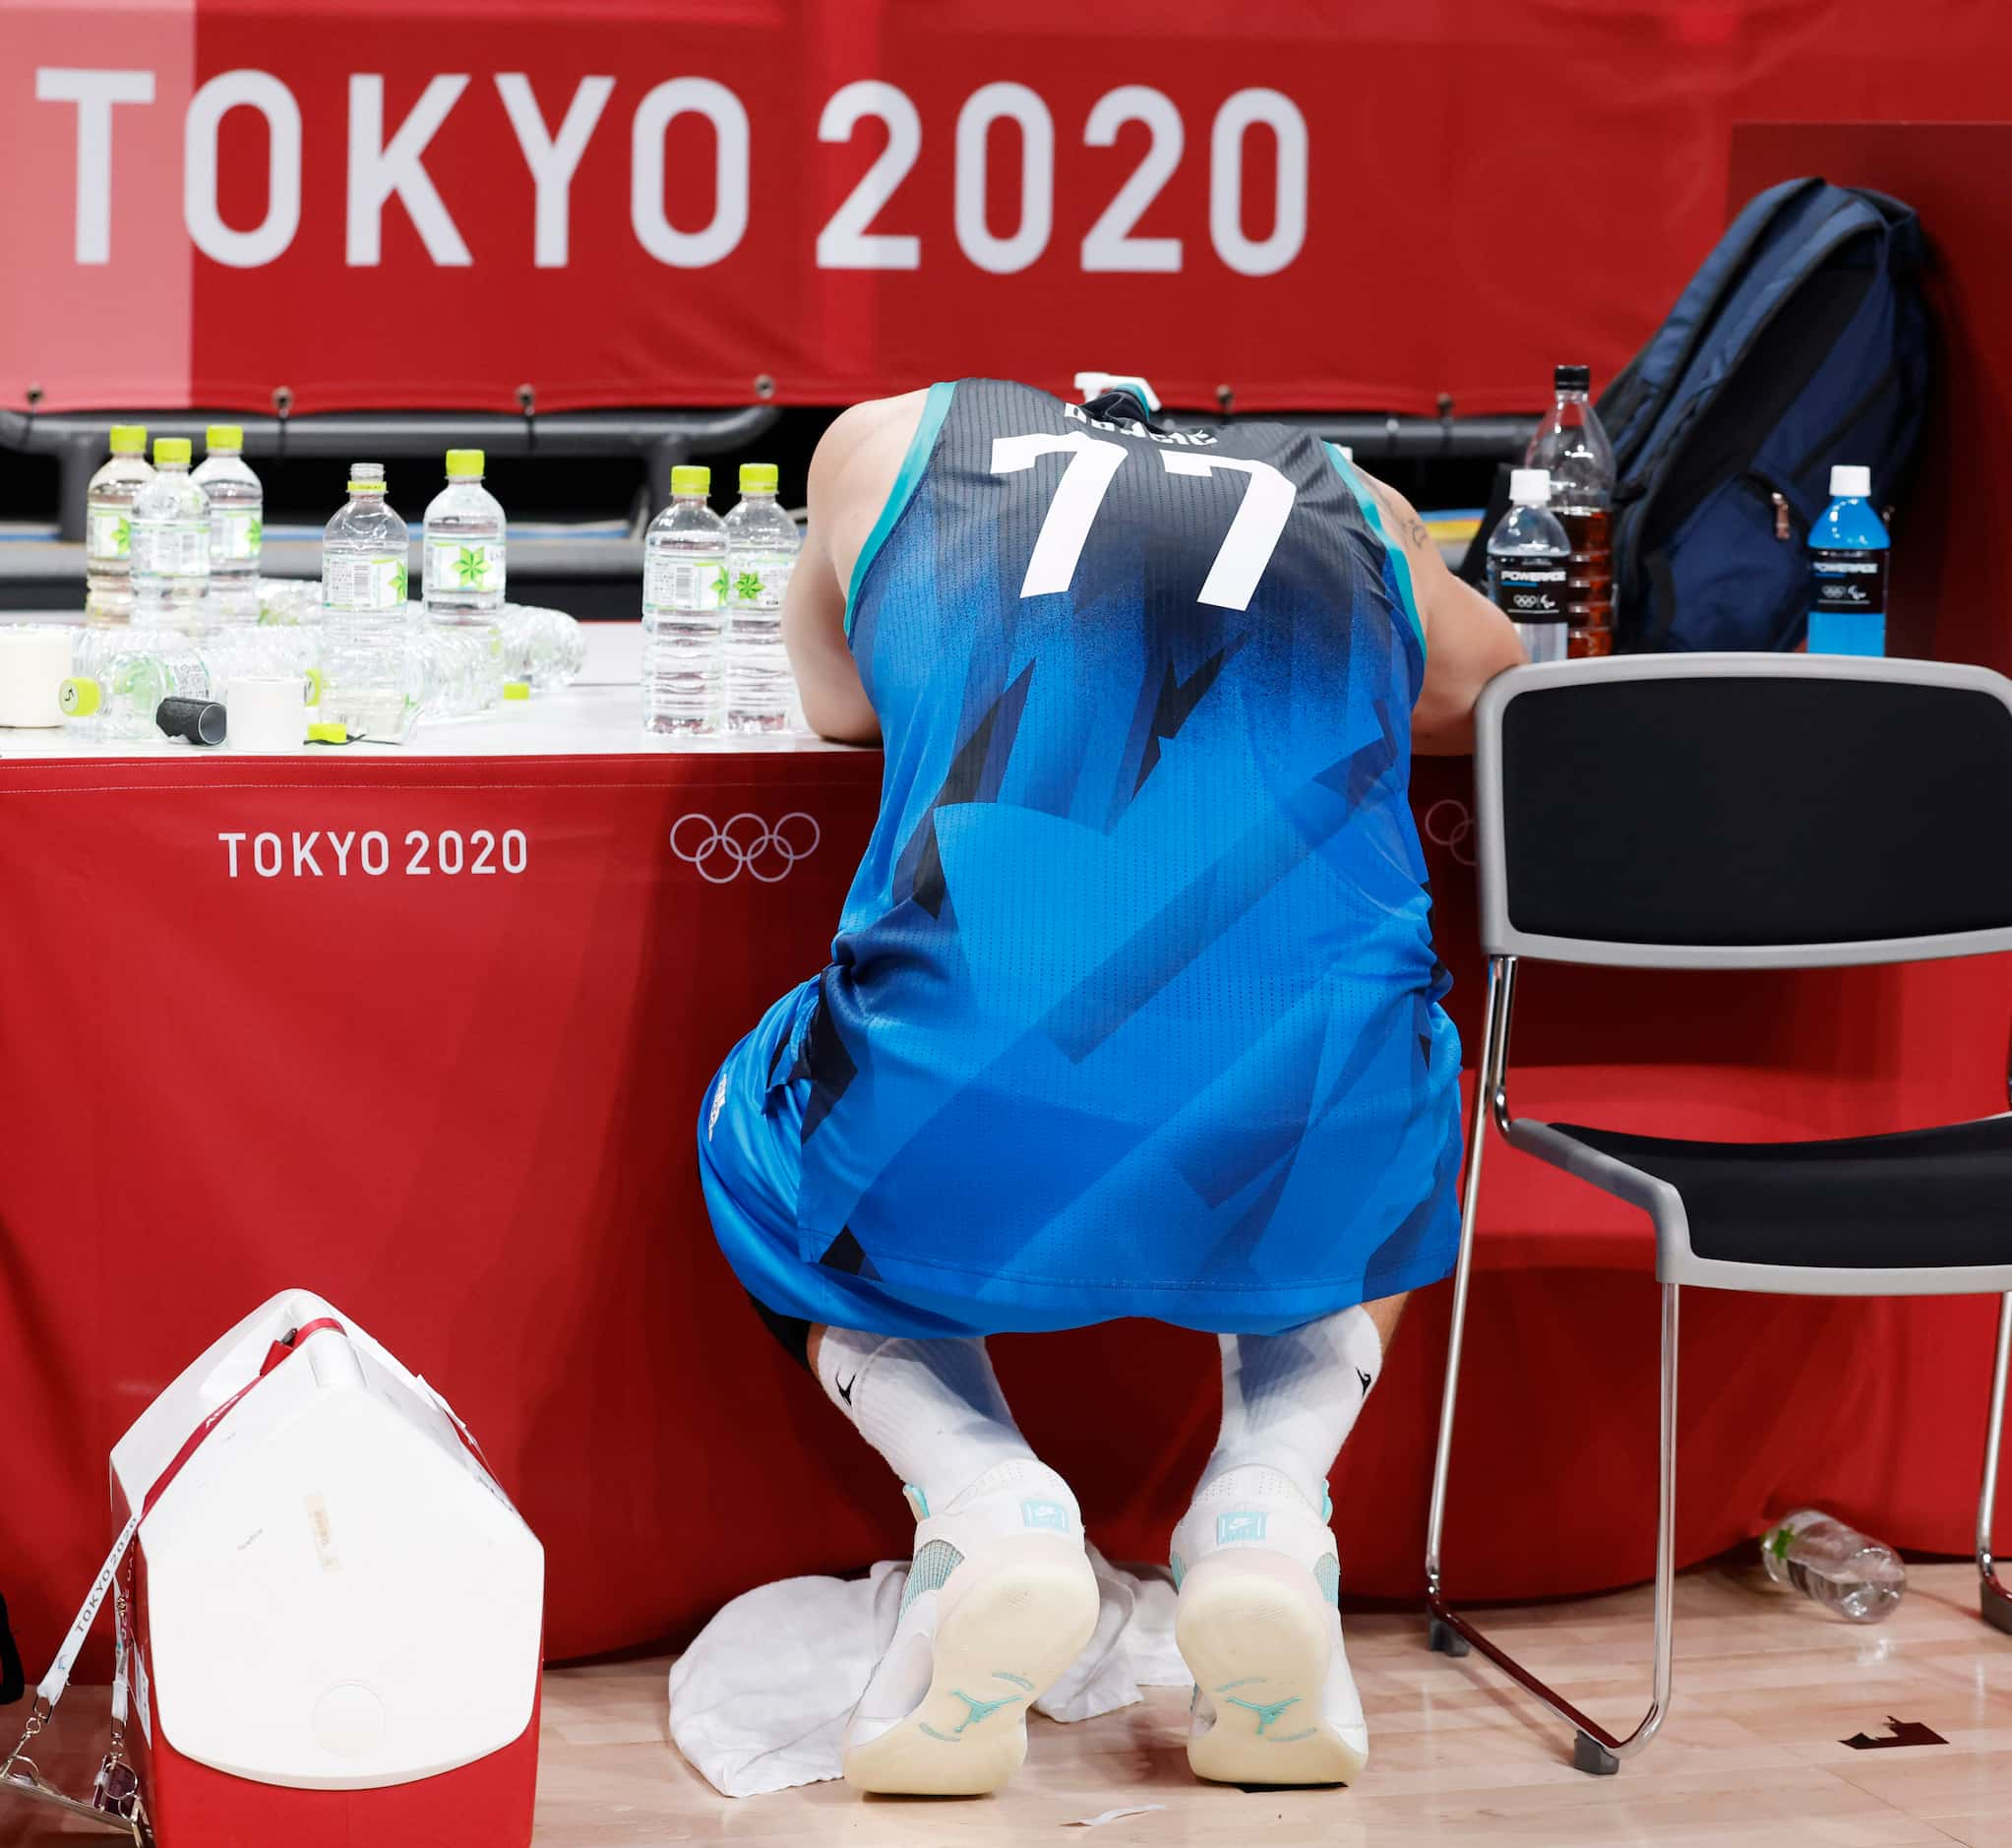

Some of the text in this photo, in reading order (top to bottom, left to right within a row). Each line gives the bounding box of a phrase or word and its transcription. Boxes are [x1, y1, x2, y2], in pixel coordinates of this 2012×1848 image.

[35, 67, 1310, 277] TOKYO 2020
[990, 430, 1297, 612] 77
[217, 829, 527, 878] TOKYO 2020
[75, 1568, 112, 1633] TOKYO
[108, 1516, 138, 1567] 2020
